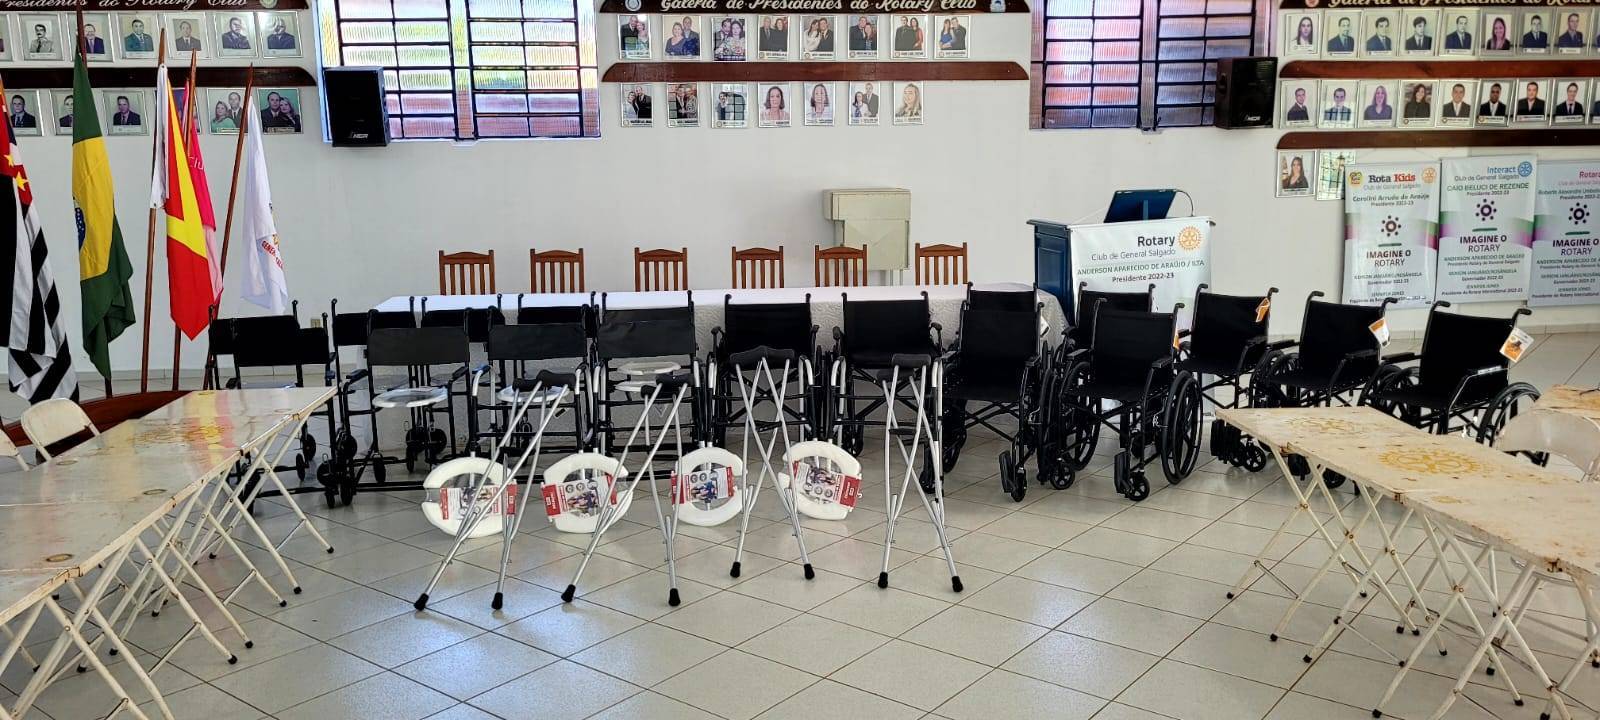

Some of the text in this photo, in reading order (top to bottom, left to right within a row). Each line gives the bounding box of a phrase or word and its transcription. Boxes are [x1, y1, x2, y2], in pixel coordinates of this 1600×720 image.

[661, 0, 977, 11] Galeria de Presidentes do Rotary Club
[1487, 165, 1516, 173] Interact
[1368, 173, 1416, 183] Rota Kids
[1137, 235, 1176, 247] Rotary
[1459, 234, 1507, 244] IMAGINE O
[1552, 238, 1600, 247] IMAGINE O
[1468, 243, 1501, 252] ROTARY
[1561, 247, 1592, 256] ROTARY
[1091, 248, 1176, 261] Club de General Salgado
[1366, 249, 1412, 259] IMAGINE O
[1077, 266, 1113, 275] ANDERSON
[1113, 263, 1149, 272] APARECIDO
[1150, 262, 1160, 270] DE
[1160, 260, 1186, 269] ARAÚJO
[1374, 258, 1405, 267] ROTARY
[1111, 271, 1175, 283] Presidente 2022-23
